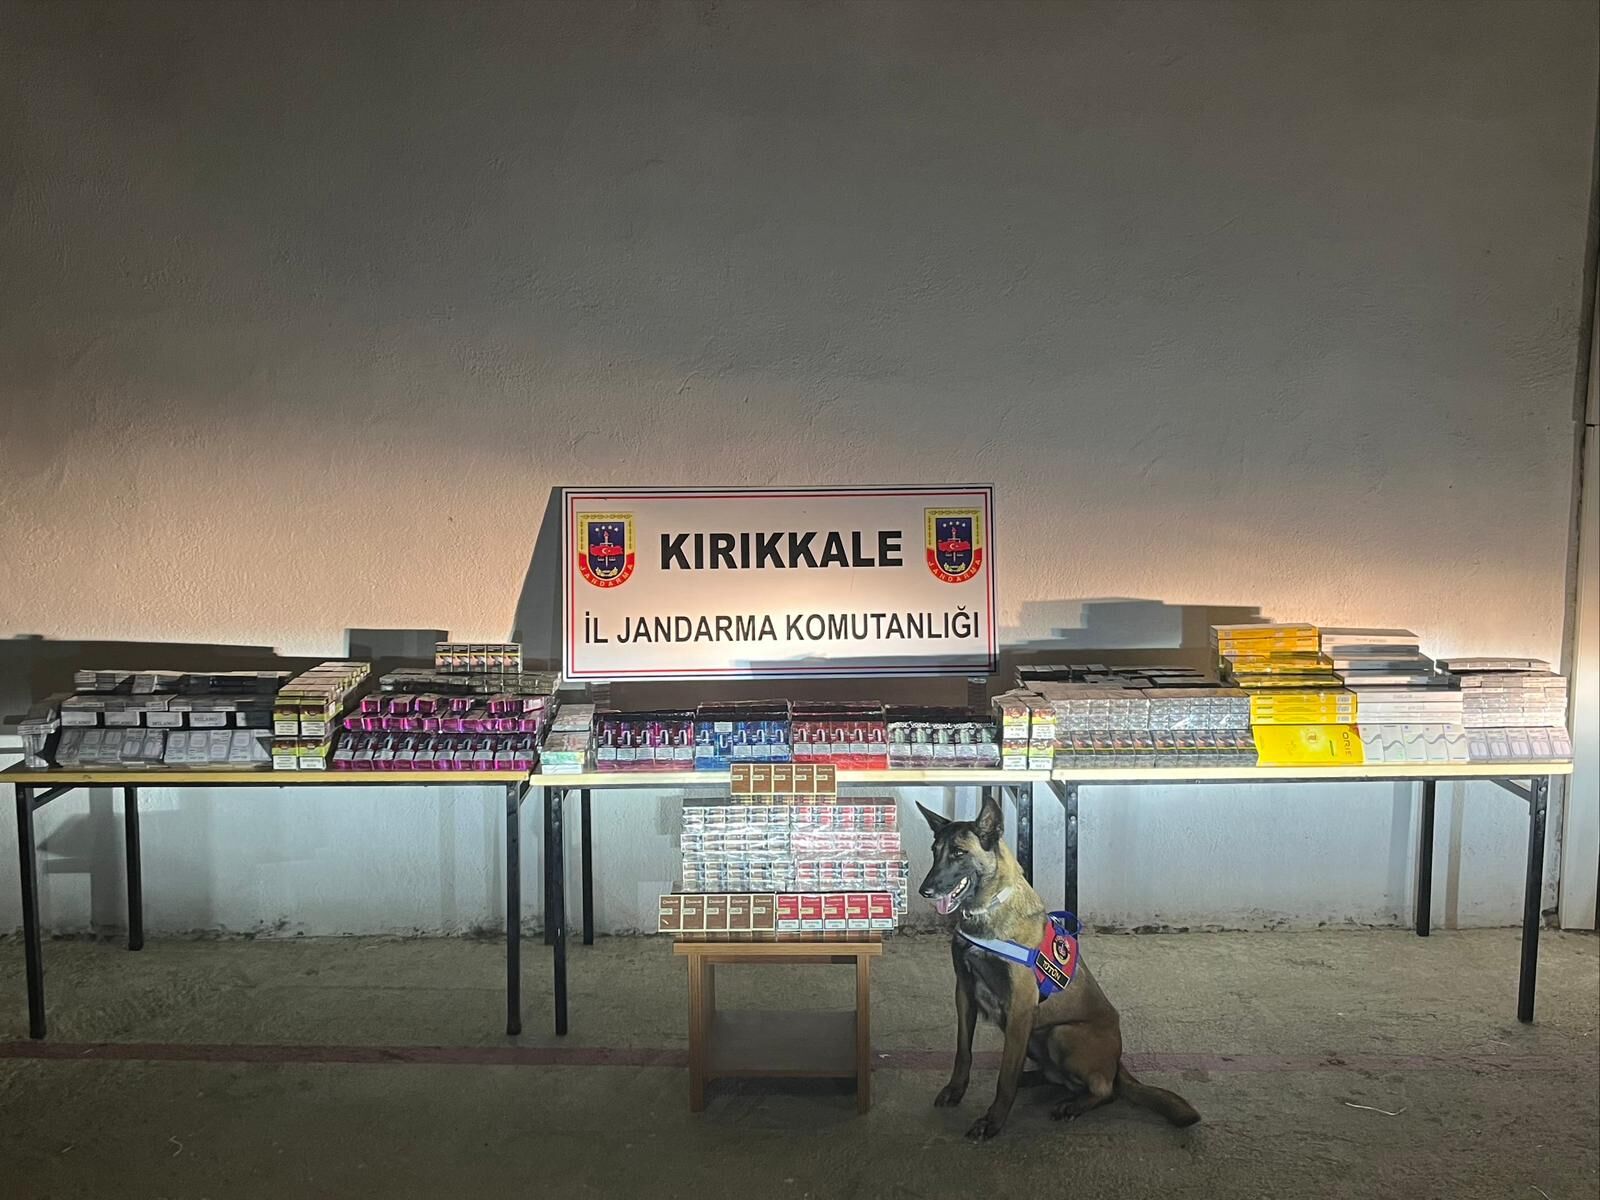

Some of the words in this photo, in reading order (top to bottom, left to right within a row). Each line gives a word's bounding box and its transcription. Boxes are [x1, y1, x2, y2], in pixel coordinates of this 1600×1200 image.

[660, 530, 903, 570] KIRIKKALE
[580, 564, 633, 587] JANDARMA
[928, 559, 981, 582] JANDARMA
[585, 611, 609, 644] İL
[616, 614, 778, 644] JANDARMA
[786, 606, 980, 641] KOMUTANLIĞI
